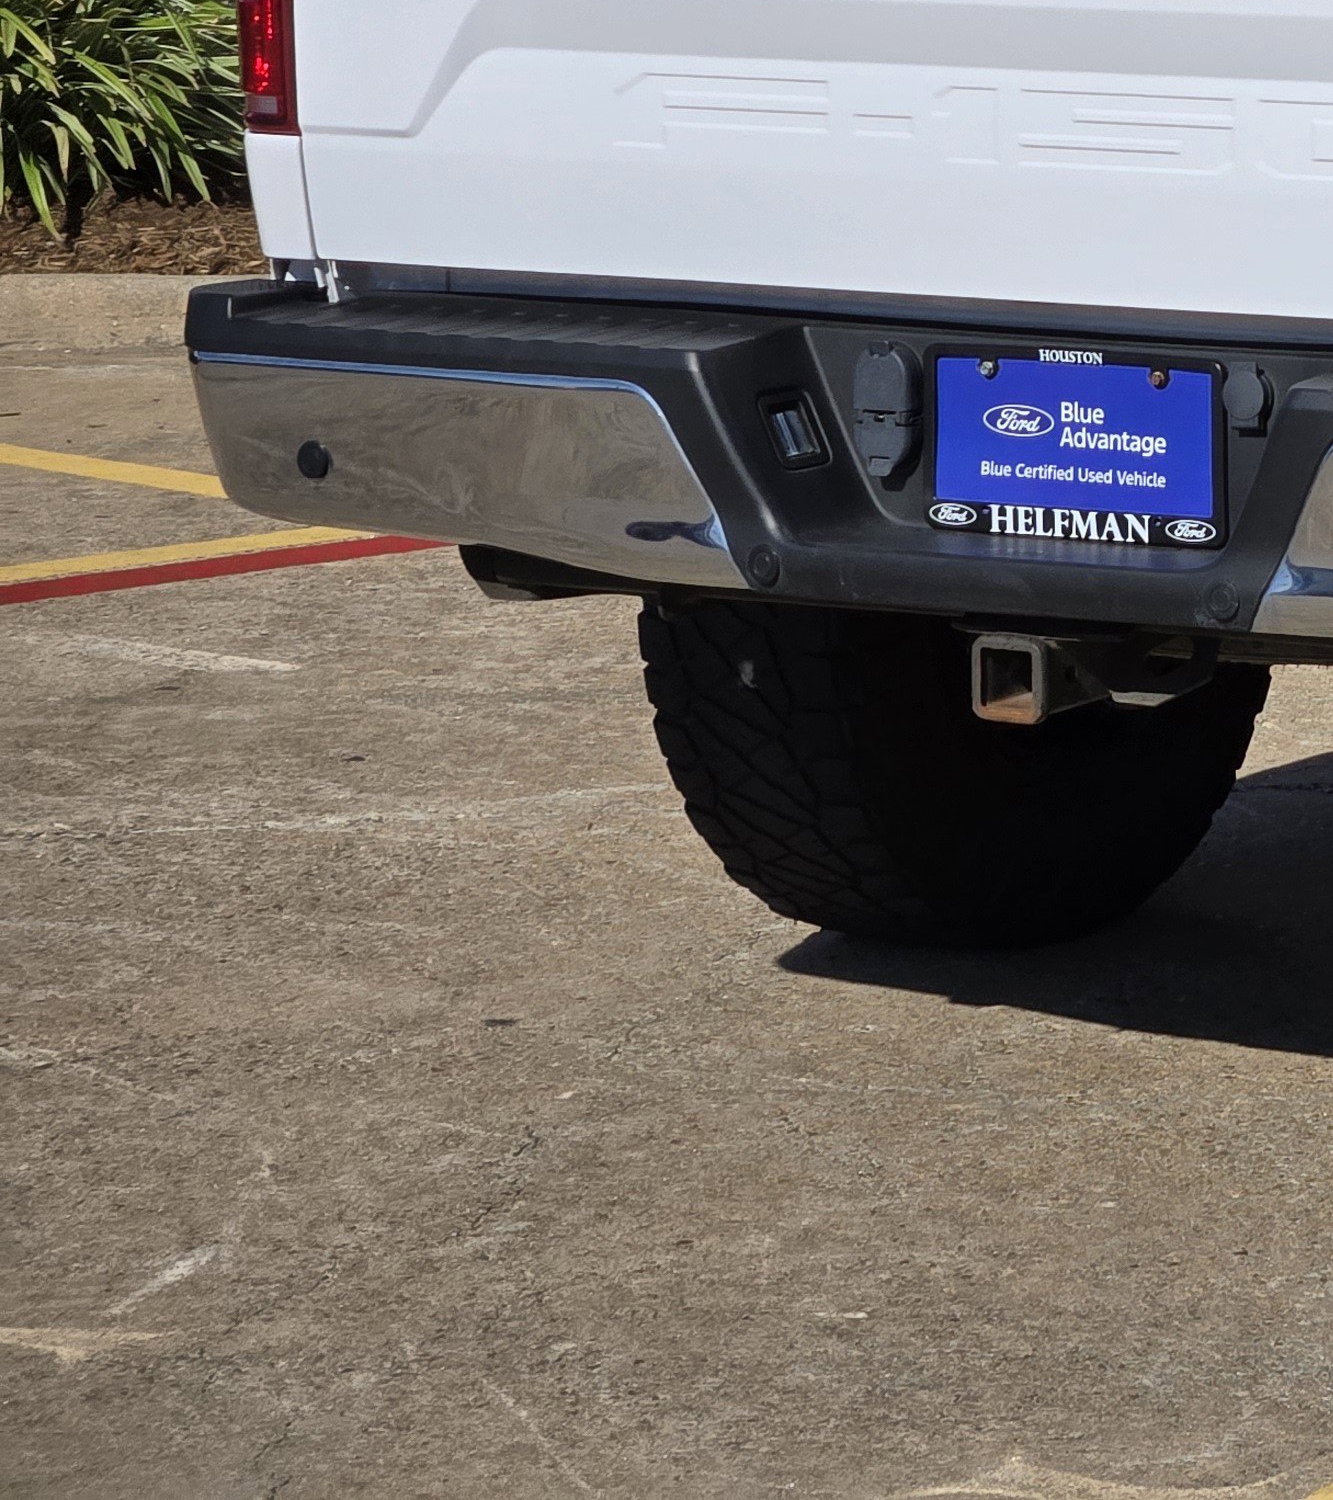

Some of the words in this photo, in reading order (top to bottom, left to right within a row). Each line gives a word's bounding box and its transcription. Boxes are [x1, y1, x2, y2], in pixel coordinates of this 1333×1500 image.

[1038, 348, 1103, 365] HOUSTON
[1060, 401, 1105, 425] Blue
[1059, 426, 1167, 457] Advantage
[980, 460, 1012, 478] Blue
[1015, 462, 1074, 482] Certified
[1077, 467, 1113, 485] Used
[1116, 469, 1167, 488] Vehicle
[989, 503, 1152, 544] HELFMAN
